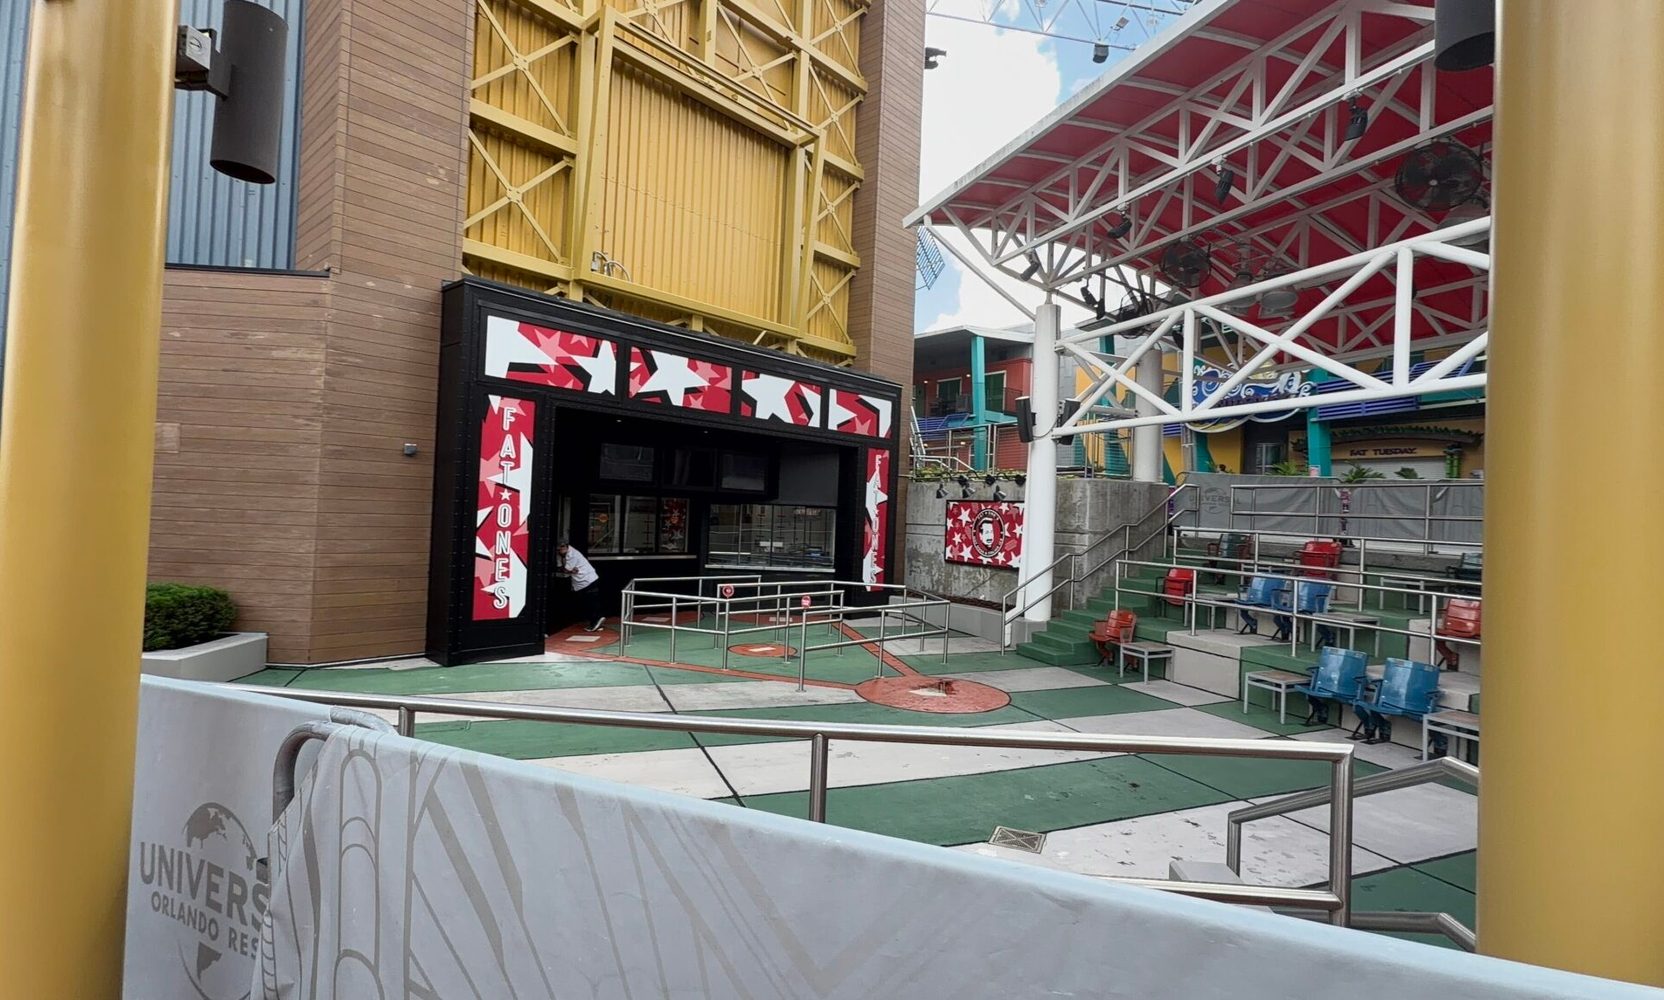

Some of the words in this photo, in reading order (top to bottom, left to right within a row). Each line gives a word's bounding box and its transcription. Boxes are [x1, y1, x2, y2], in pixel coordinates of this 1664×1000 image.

[500, 407, 516, 484] FAT
[1349, 449, 1368, 457] FAT
[493, 503, 514, 609] ONES
[151, 890, 219, 941] ORLANDO
